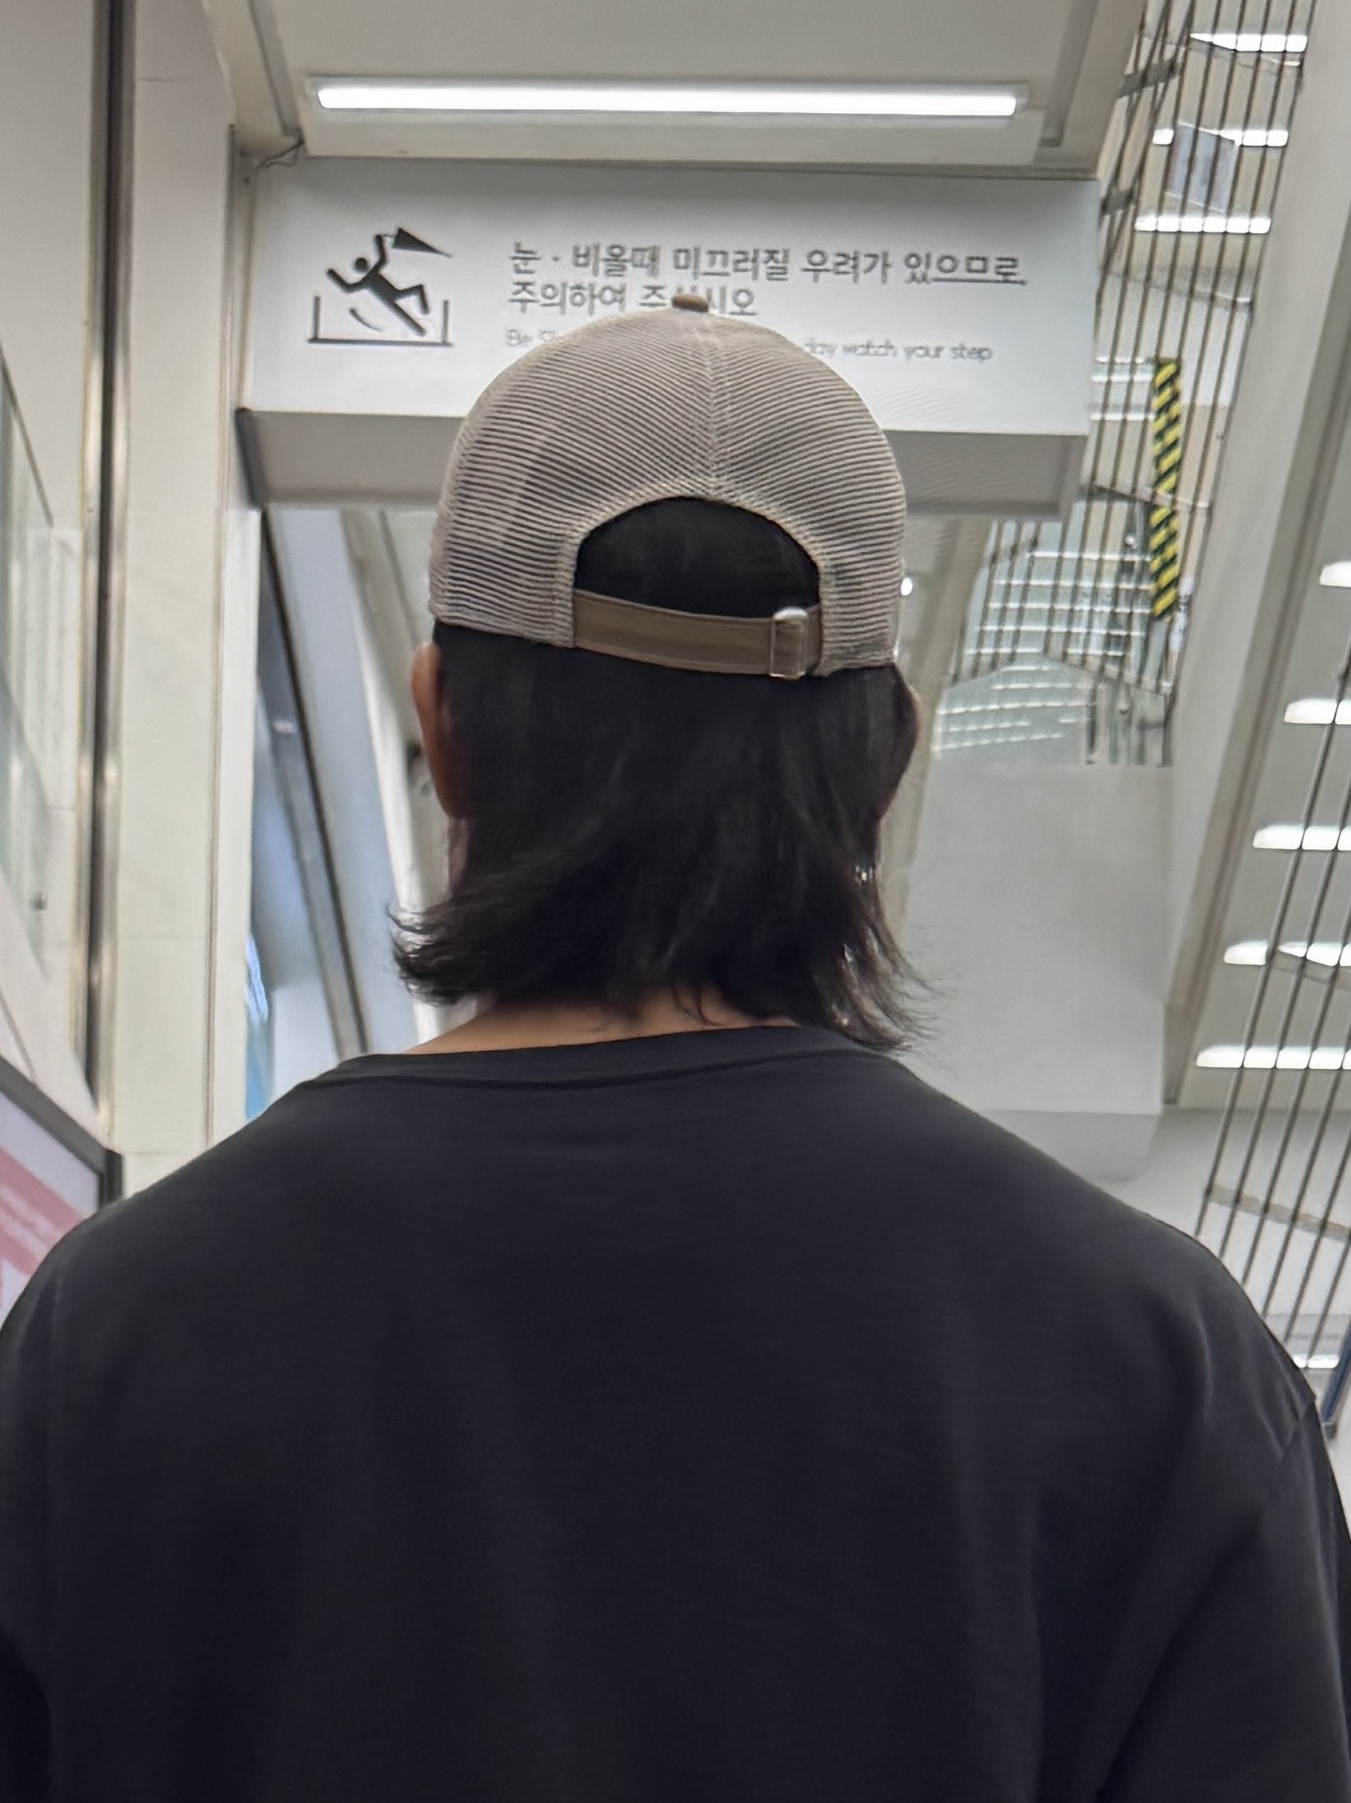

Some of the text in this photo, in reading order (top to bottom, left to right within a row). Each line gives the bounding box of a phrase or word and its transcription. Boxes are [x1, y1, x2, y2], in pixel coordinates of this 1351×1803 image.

[673, 245, 790, 282] 미끄러질
[801, 249, 892, 284] 우려가
[904, 252, 1028, 286] 있으므로
[509, 282, 627, 315] 주의하여
[902, 344, 945, 362] your
[950, 342, 994, 363] step
